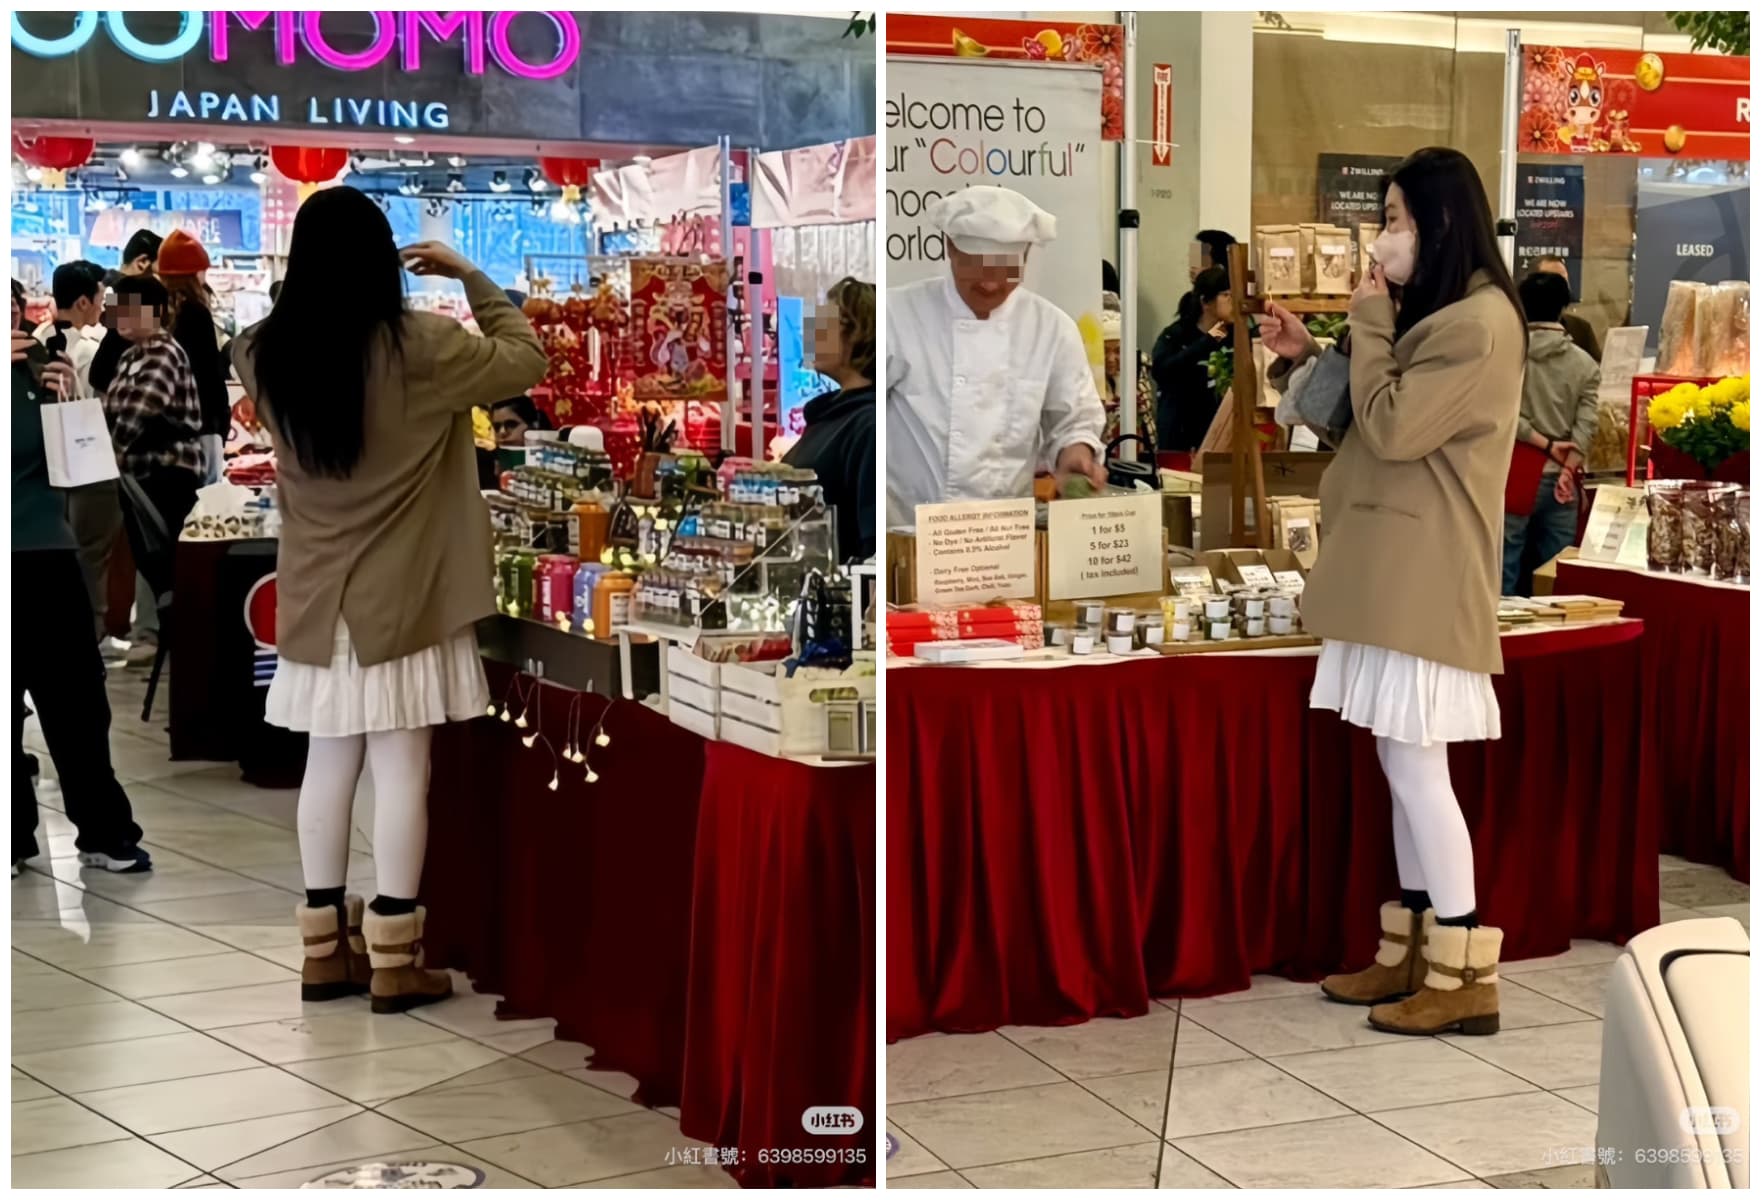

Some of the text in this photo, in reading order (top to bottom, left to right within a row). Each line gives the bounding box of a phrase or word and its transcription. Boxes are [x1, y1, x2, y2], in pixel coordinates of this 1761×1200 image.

[147, 90, 450, 128] JAPAN LIVING
[886, 92, 1046, 133] elcome to
[1535, 176, 1566, 185] ZWILLING
[1339, 191, 1378, 200] WE ARE NO
[1331, 202, 1361, 210] LOCATED
[1524, 199, 1567, 208] WE ARE NOW
[1676, 243, 1714, 257] LEASED
[928, 509, 1029, 523] FOOD ALLERGY INFORMATION
[944, 528, 966, 536] Gluten
[968, 526, 983, 534] Free
[1092, 523, 1126, 535] 1 for $5
[944, 538, 958, 546] Dye
[1089, 539, 1129, 550] 5 for $23
[933, 548, 964, 556] Contains
[984, 544, 1010, 552] Alcohol
[1088, 553, 1132, 566] 10 for $42
[933, 568, 952, 576] Dairy
[953, 566, 969, 574] Free
